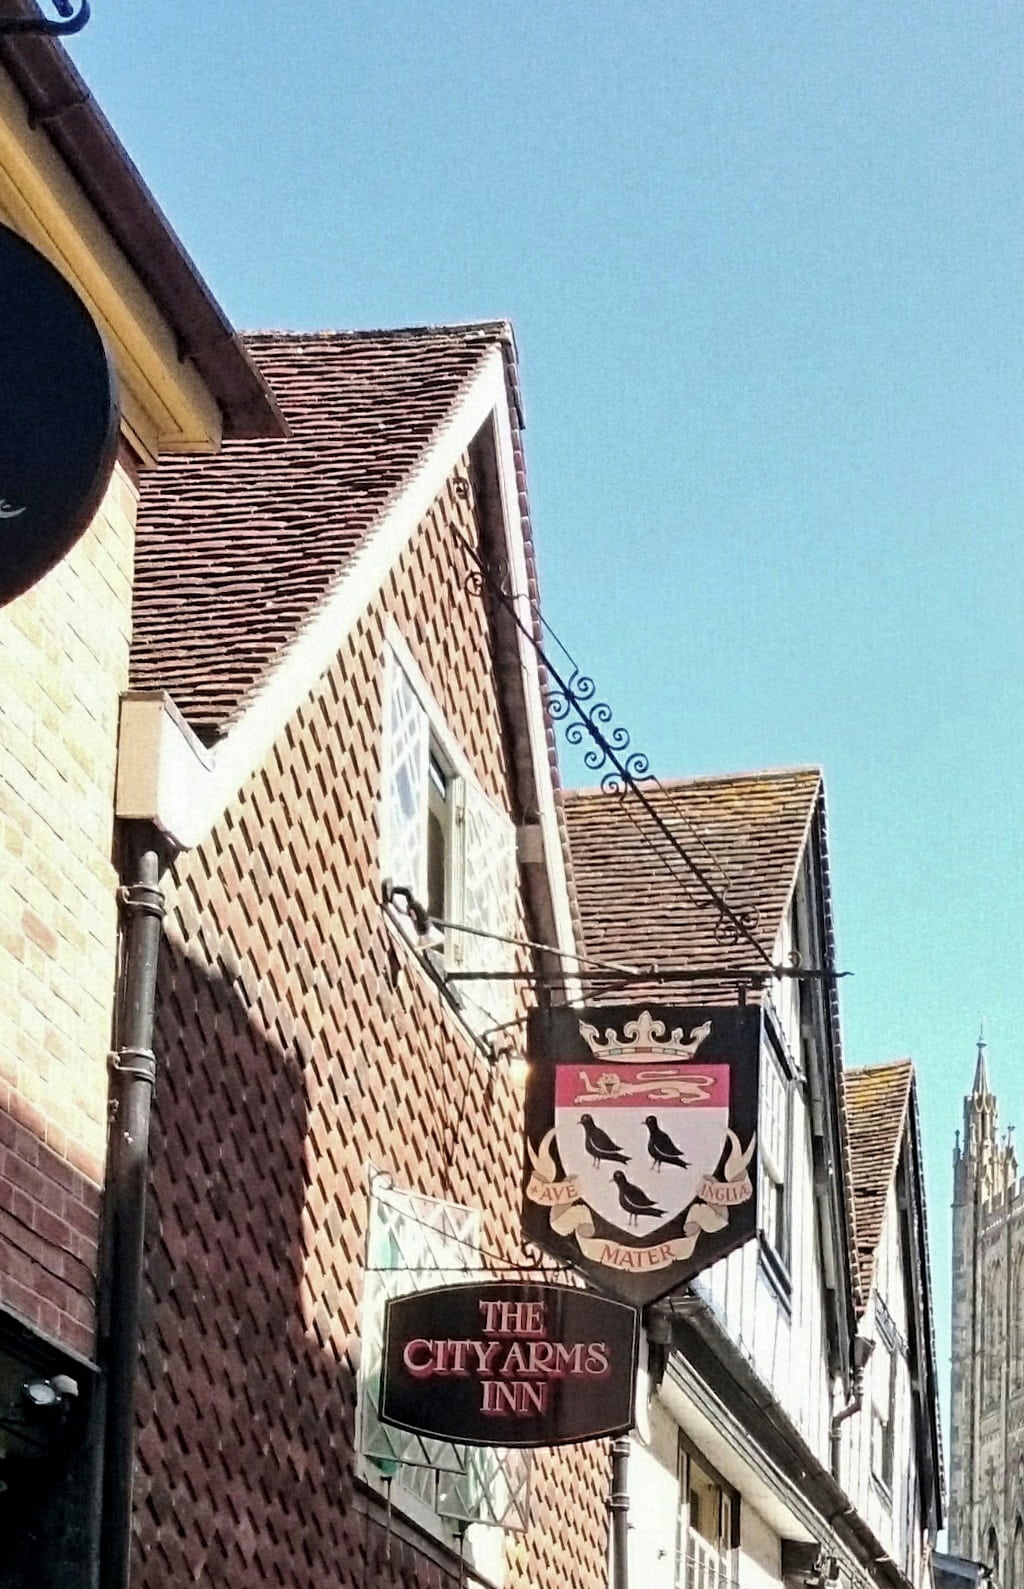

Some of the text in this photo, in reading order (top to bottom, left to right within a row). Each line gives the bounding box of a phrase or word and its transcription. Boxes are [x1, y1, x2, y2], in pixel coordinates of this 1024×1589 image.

[539, 1184, 578, 1201] AVE
[600, 1244, 675, 1268] MATER
[479, 1299, 546, 1336] THE
[403, 1338, 609, 1376] CITY ARMS
[479, 1380, 546, 1413] INN
